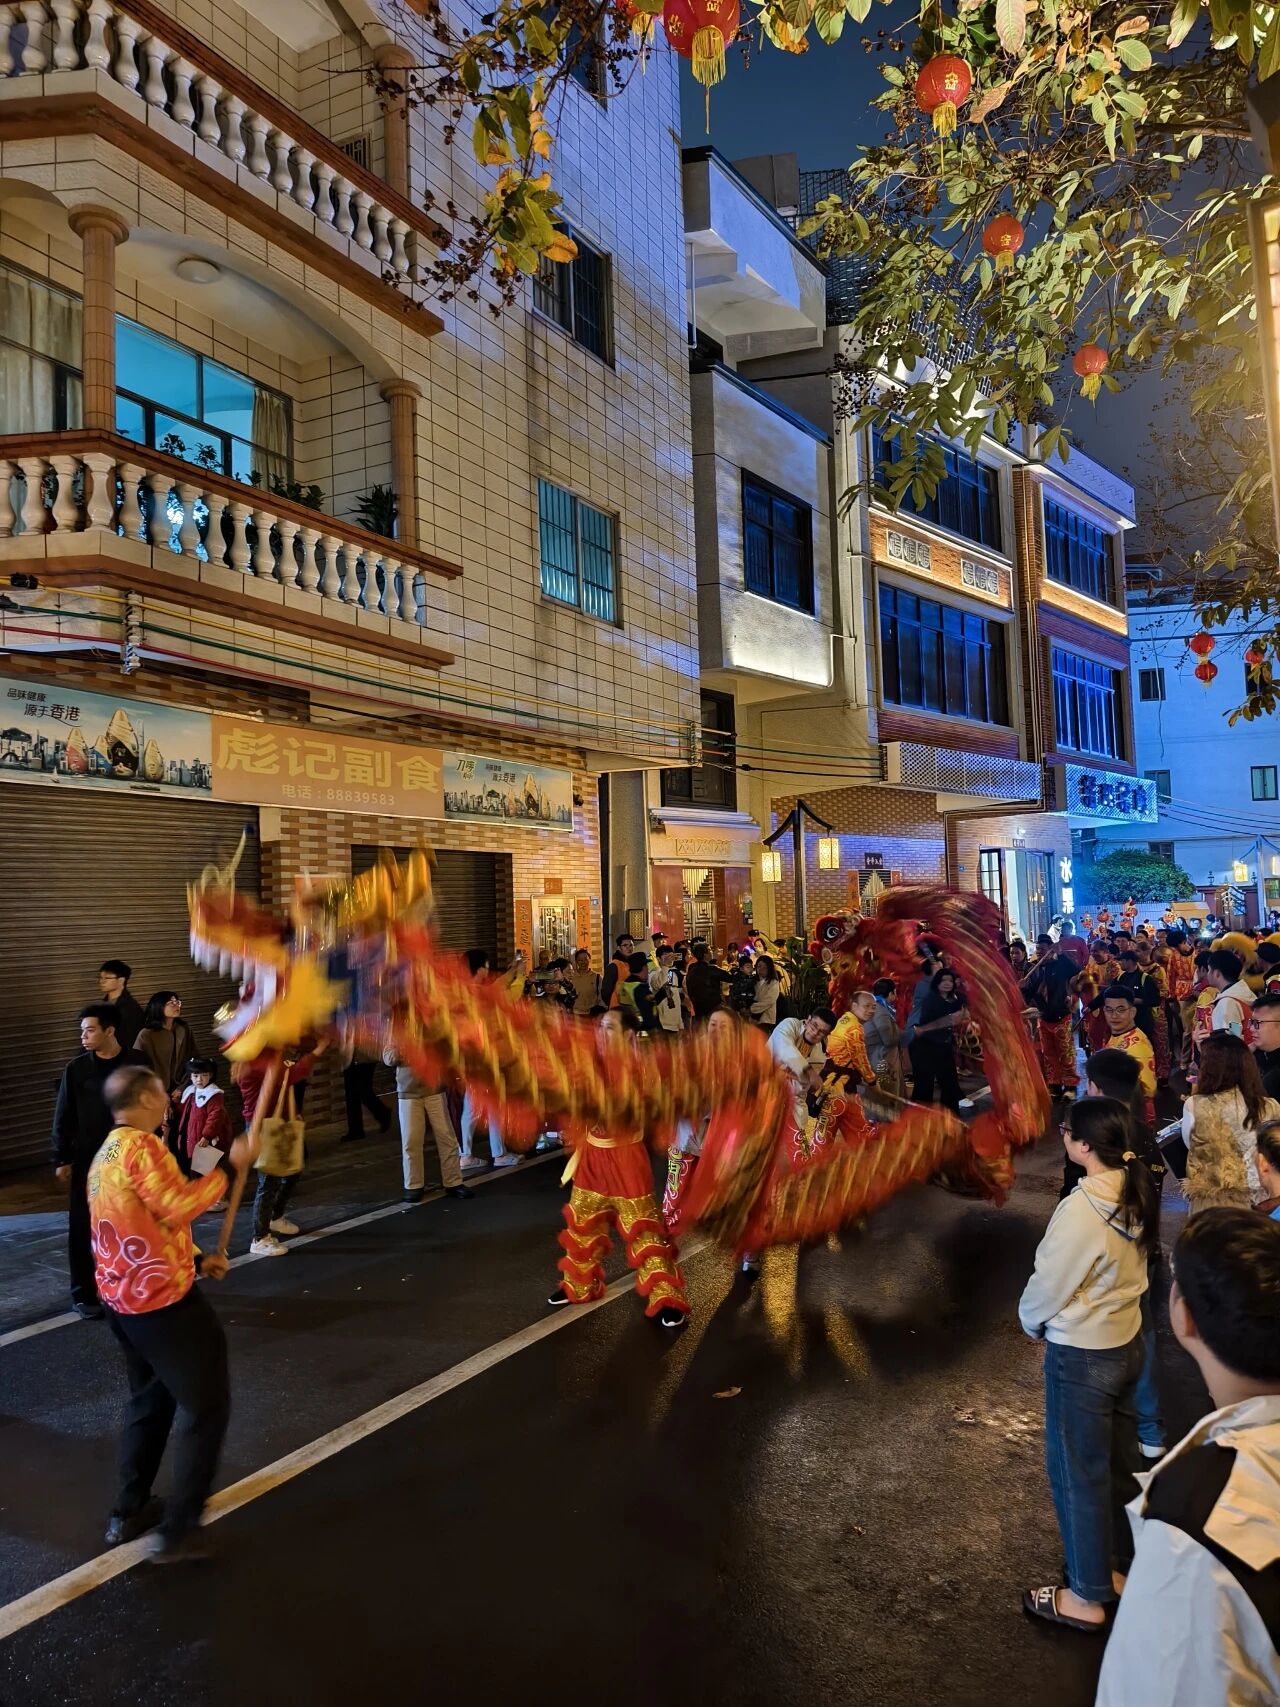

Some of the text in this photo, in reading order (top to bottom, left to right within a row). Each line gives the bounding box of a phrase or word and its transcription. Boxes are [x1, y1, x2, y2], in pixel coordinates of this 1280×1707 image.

[7, 688, 47, 702] 品味健康
[24, 704, 80, 722] 源于香港
[216, 728, 441, 793] 彪记副食
